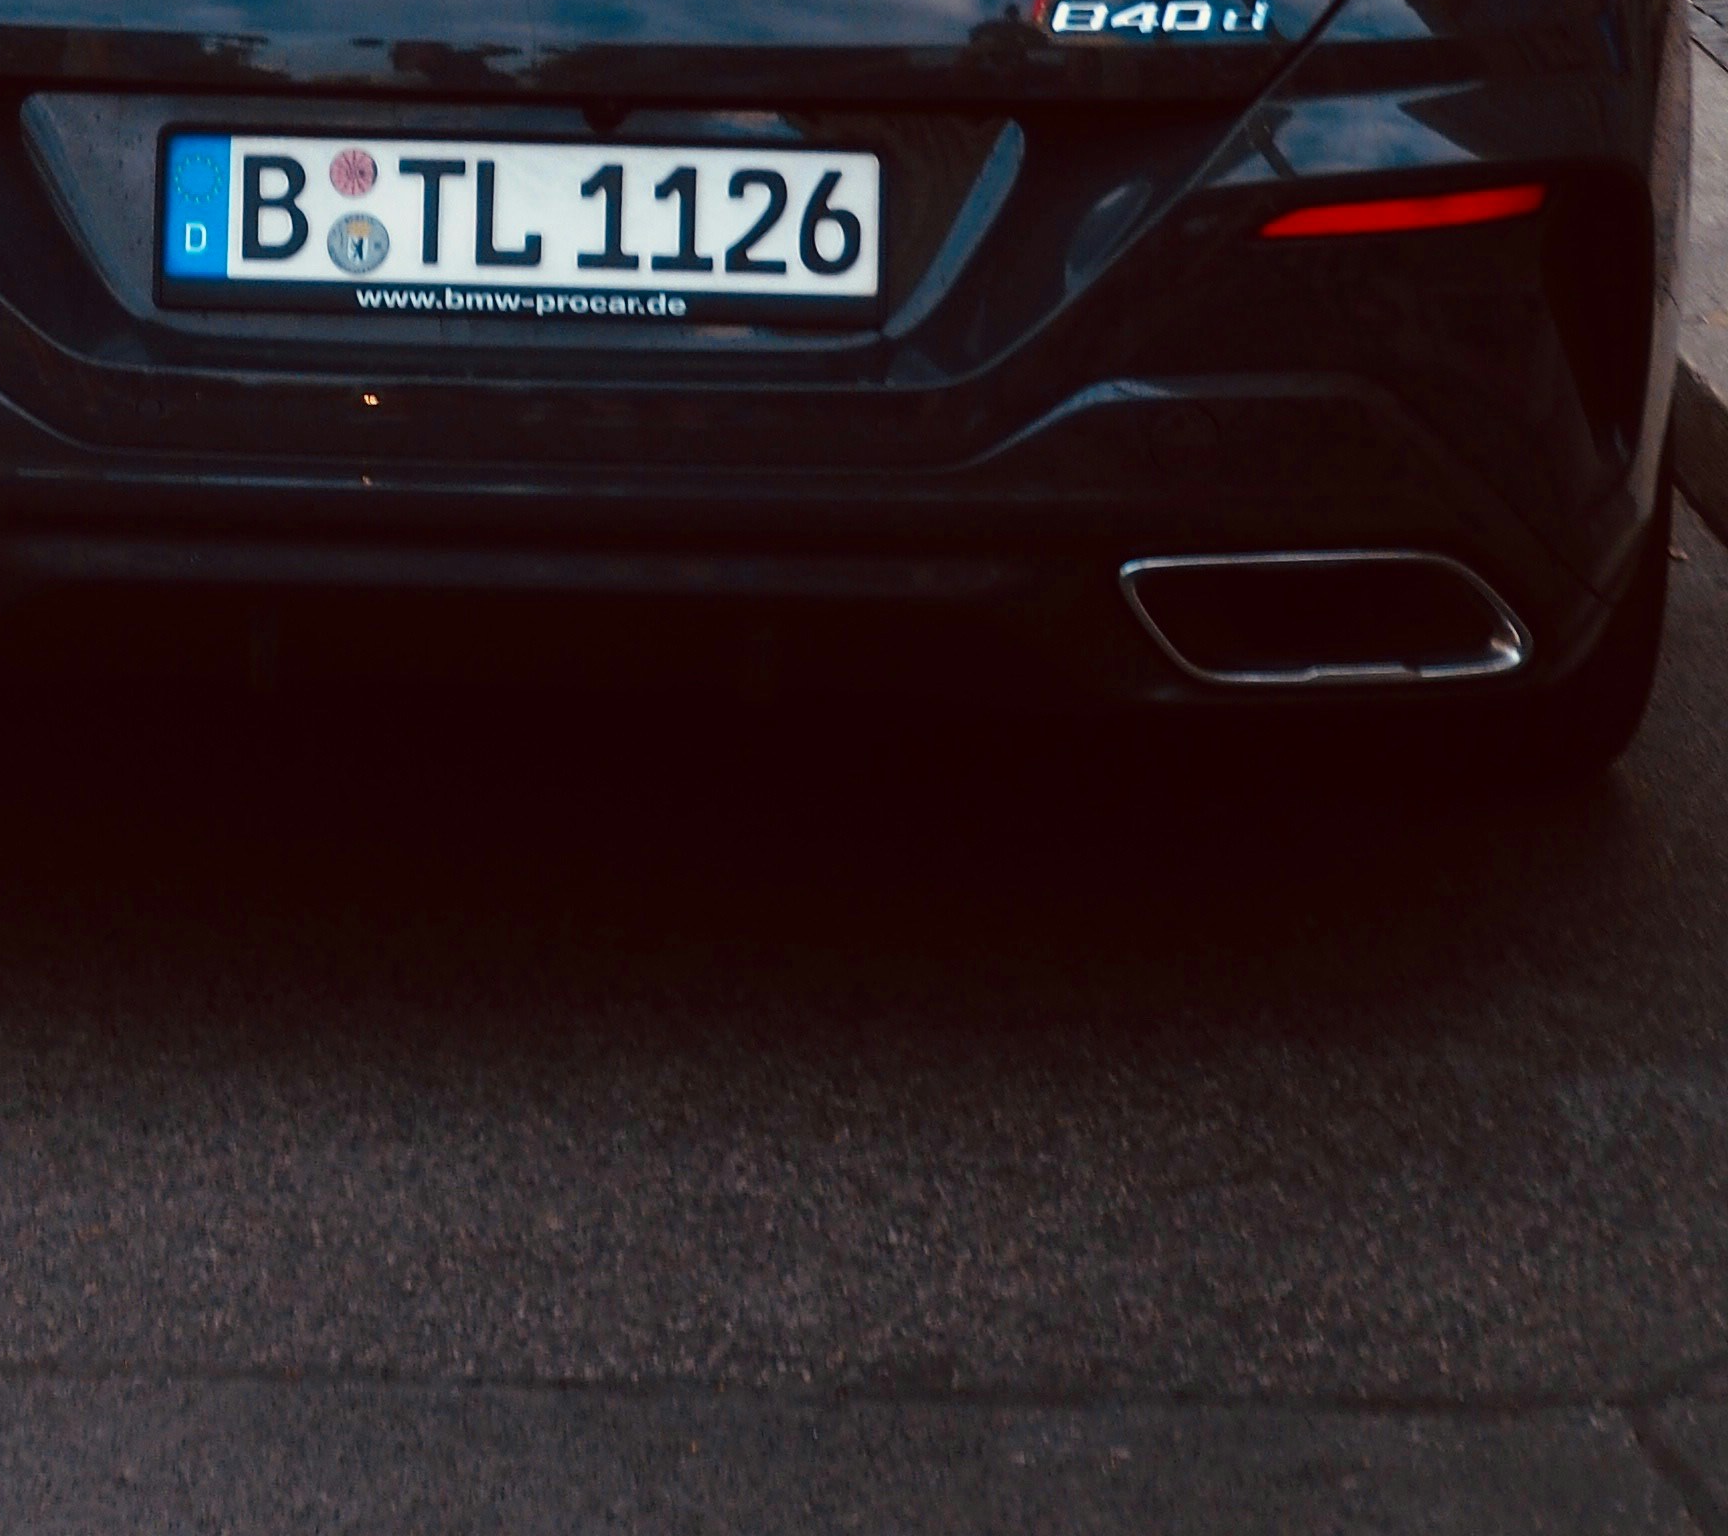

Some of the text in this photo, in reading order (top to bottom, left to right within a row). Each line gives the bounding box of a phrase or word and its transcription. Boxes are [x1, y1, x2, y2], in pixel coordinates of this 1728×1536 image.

[184, 222, 208, 254] D
[241, 154, 309, 261] B
[398, 158, 543, 267] TL
[576, 164, 863, 276] 1126
[355, 286, 688, 318] www.bmw-procar.de
